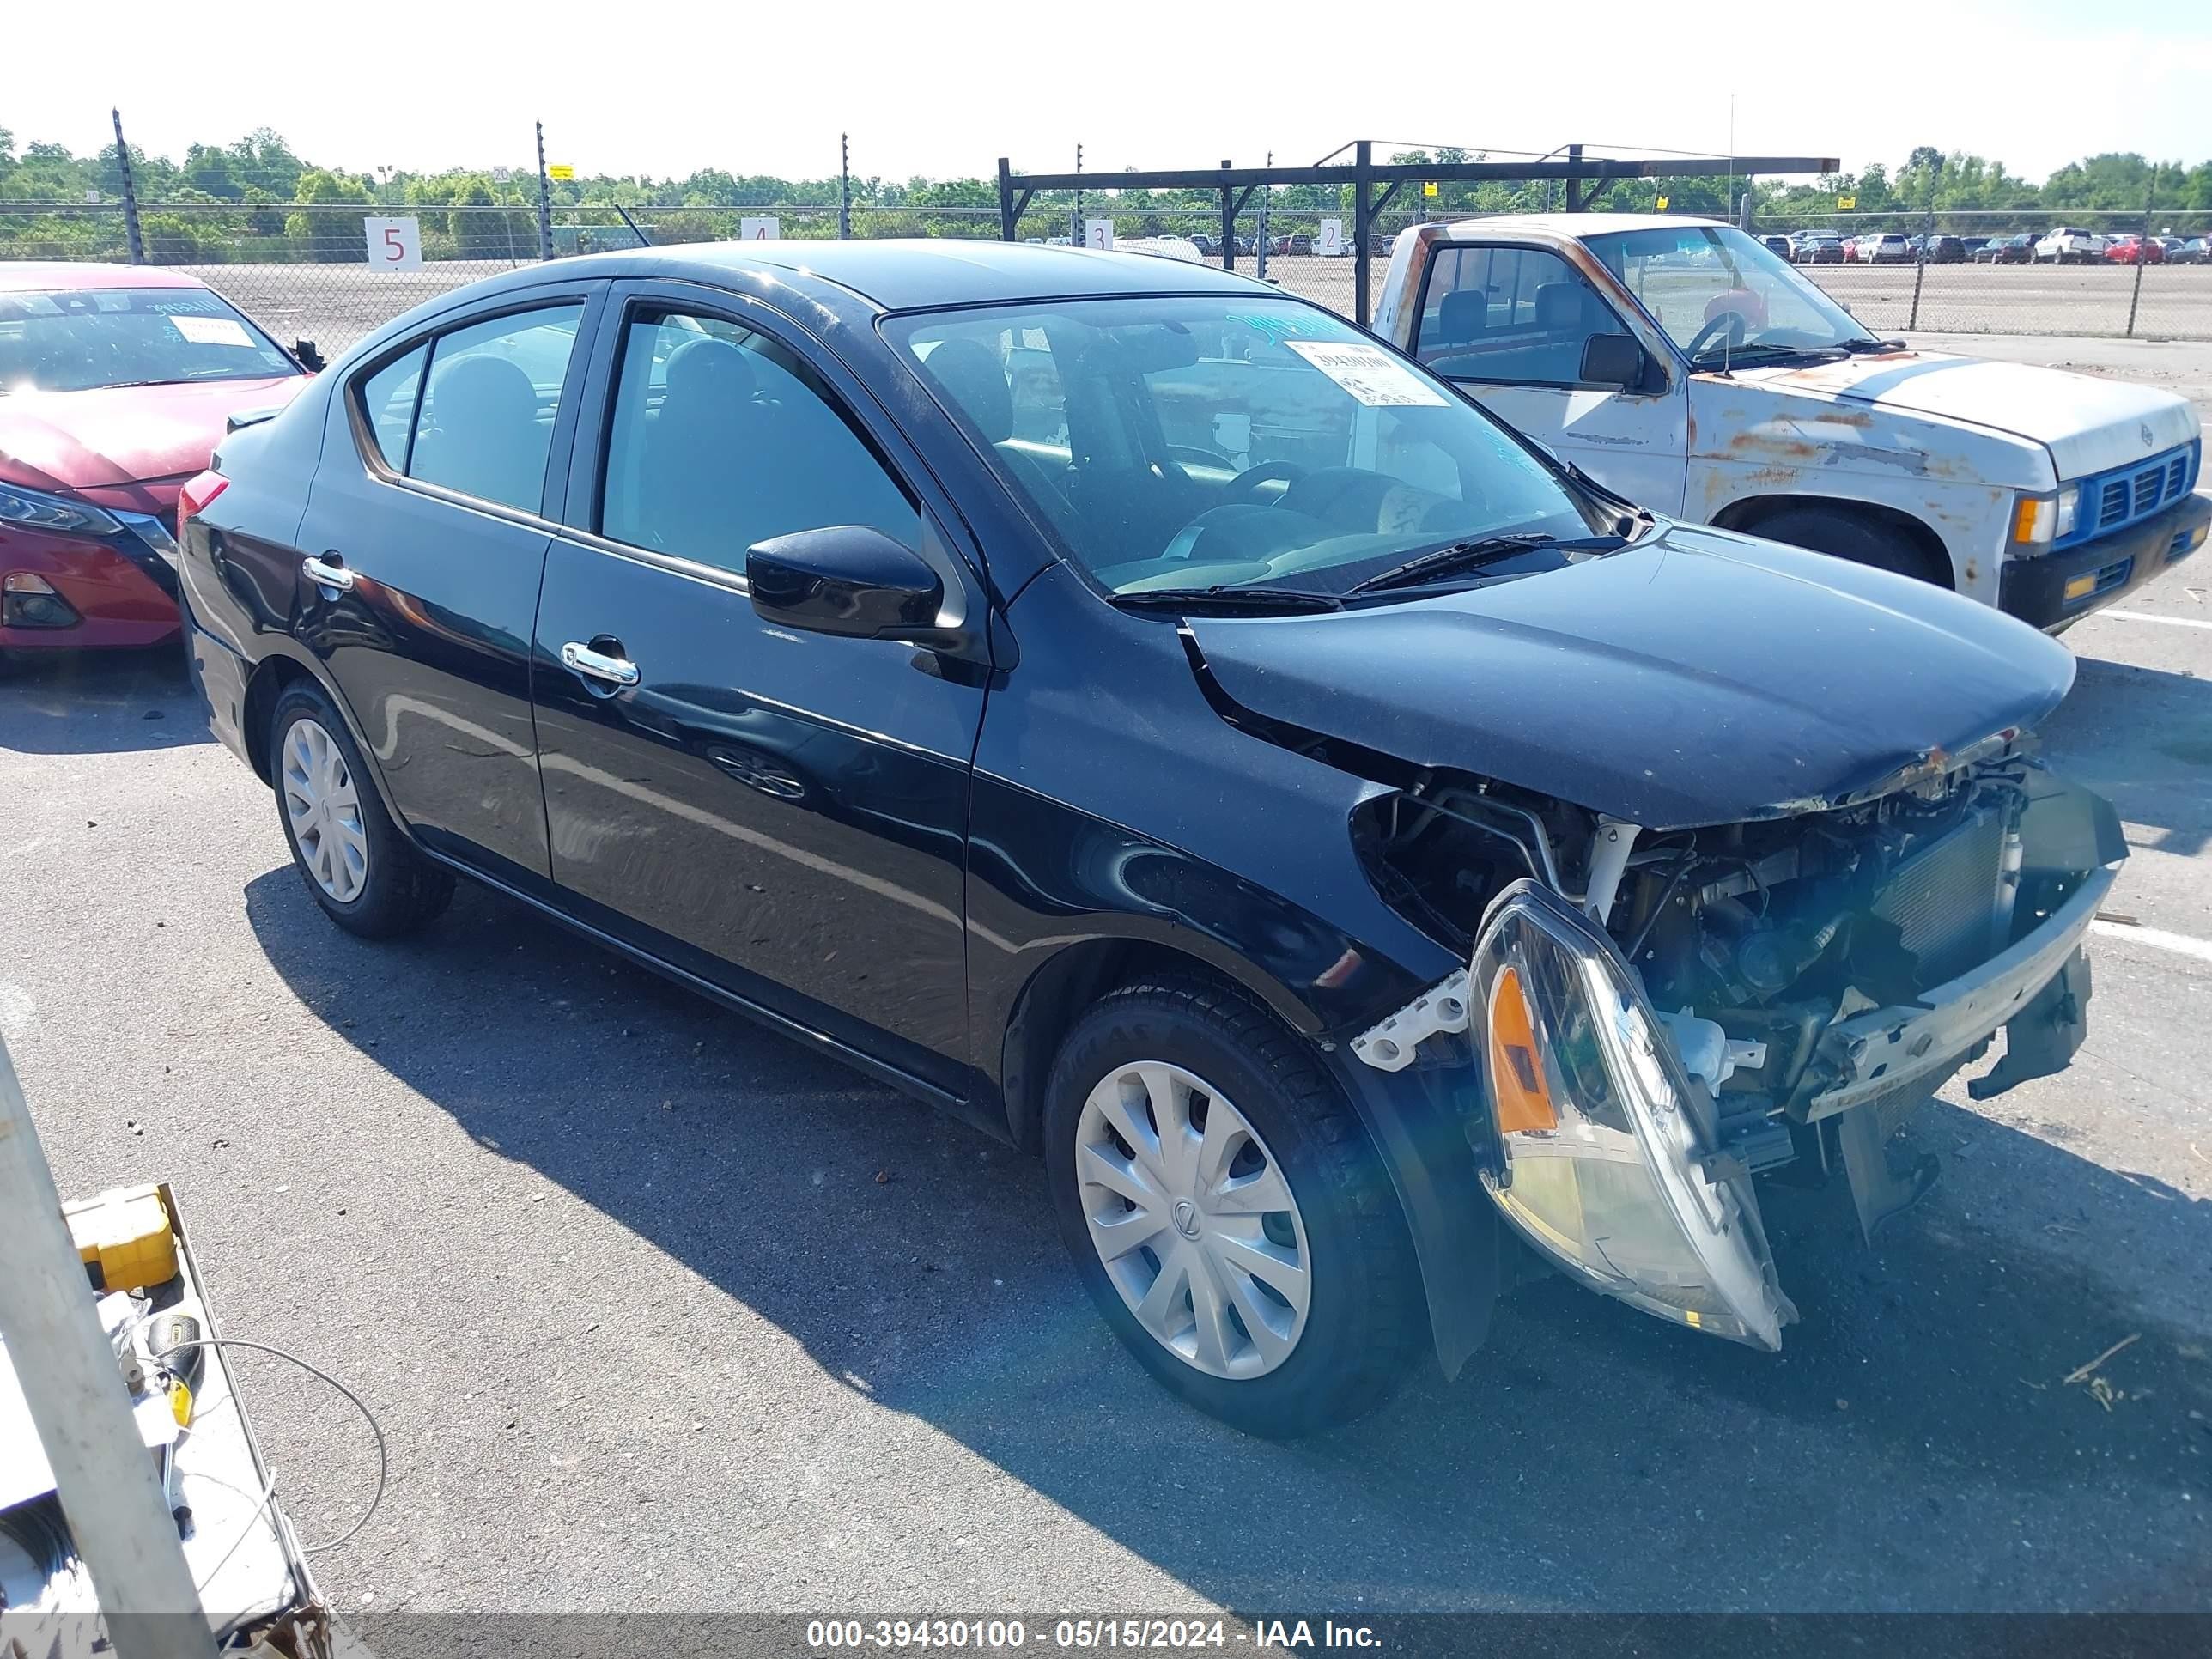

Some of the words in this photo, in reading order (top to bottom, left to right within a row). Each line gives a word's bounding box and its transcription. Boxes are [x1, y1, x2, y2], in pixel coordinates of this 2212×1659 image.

[495, 169, 508, 180] 20
[385, 228, 404, 261] 5
[1095, 228, 1105, 249] 3
[1327, 227, 1334, 247] 2
[1314, 353, 1391, 368] 39430100
